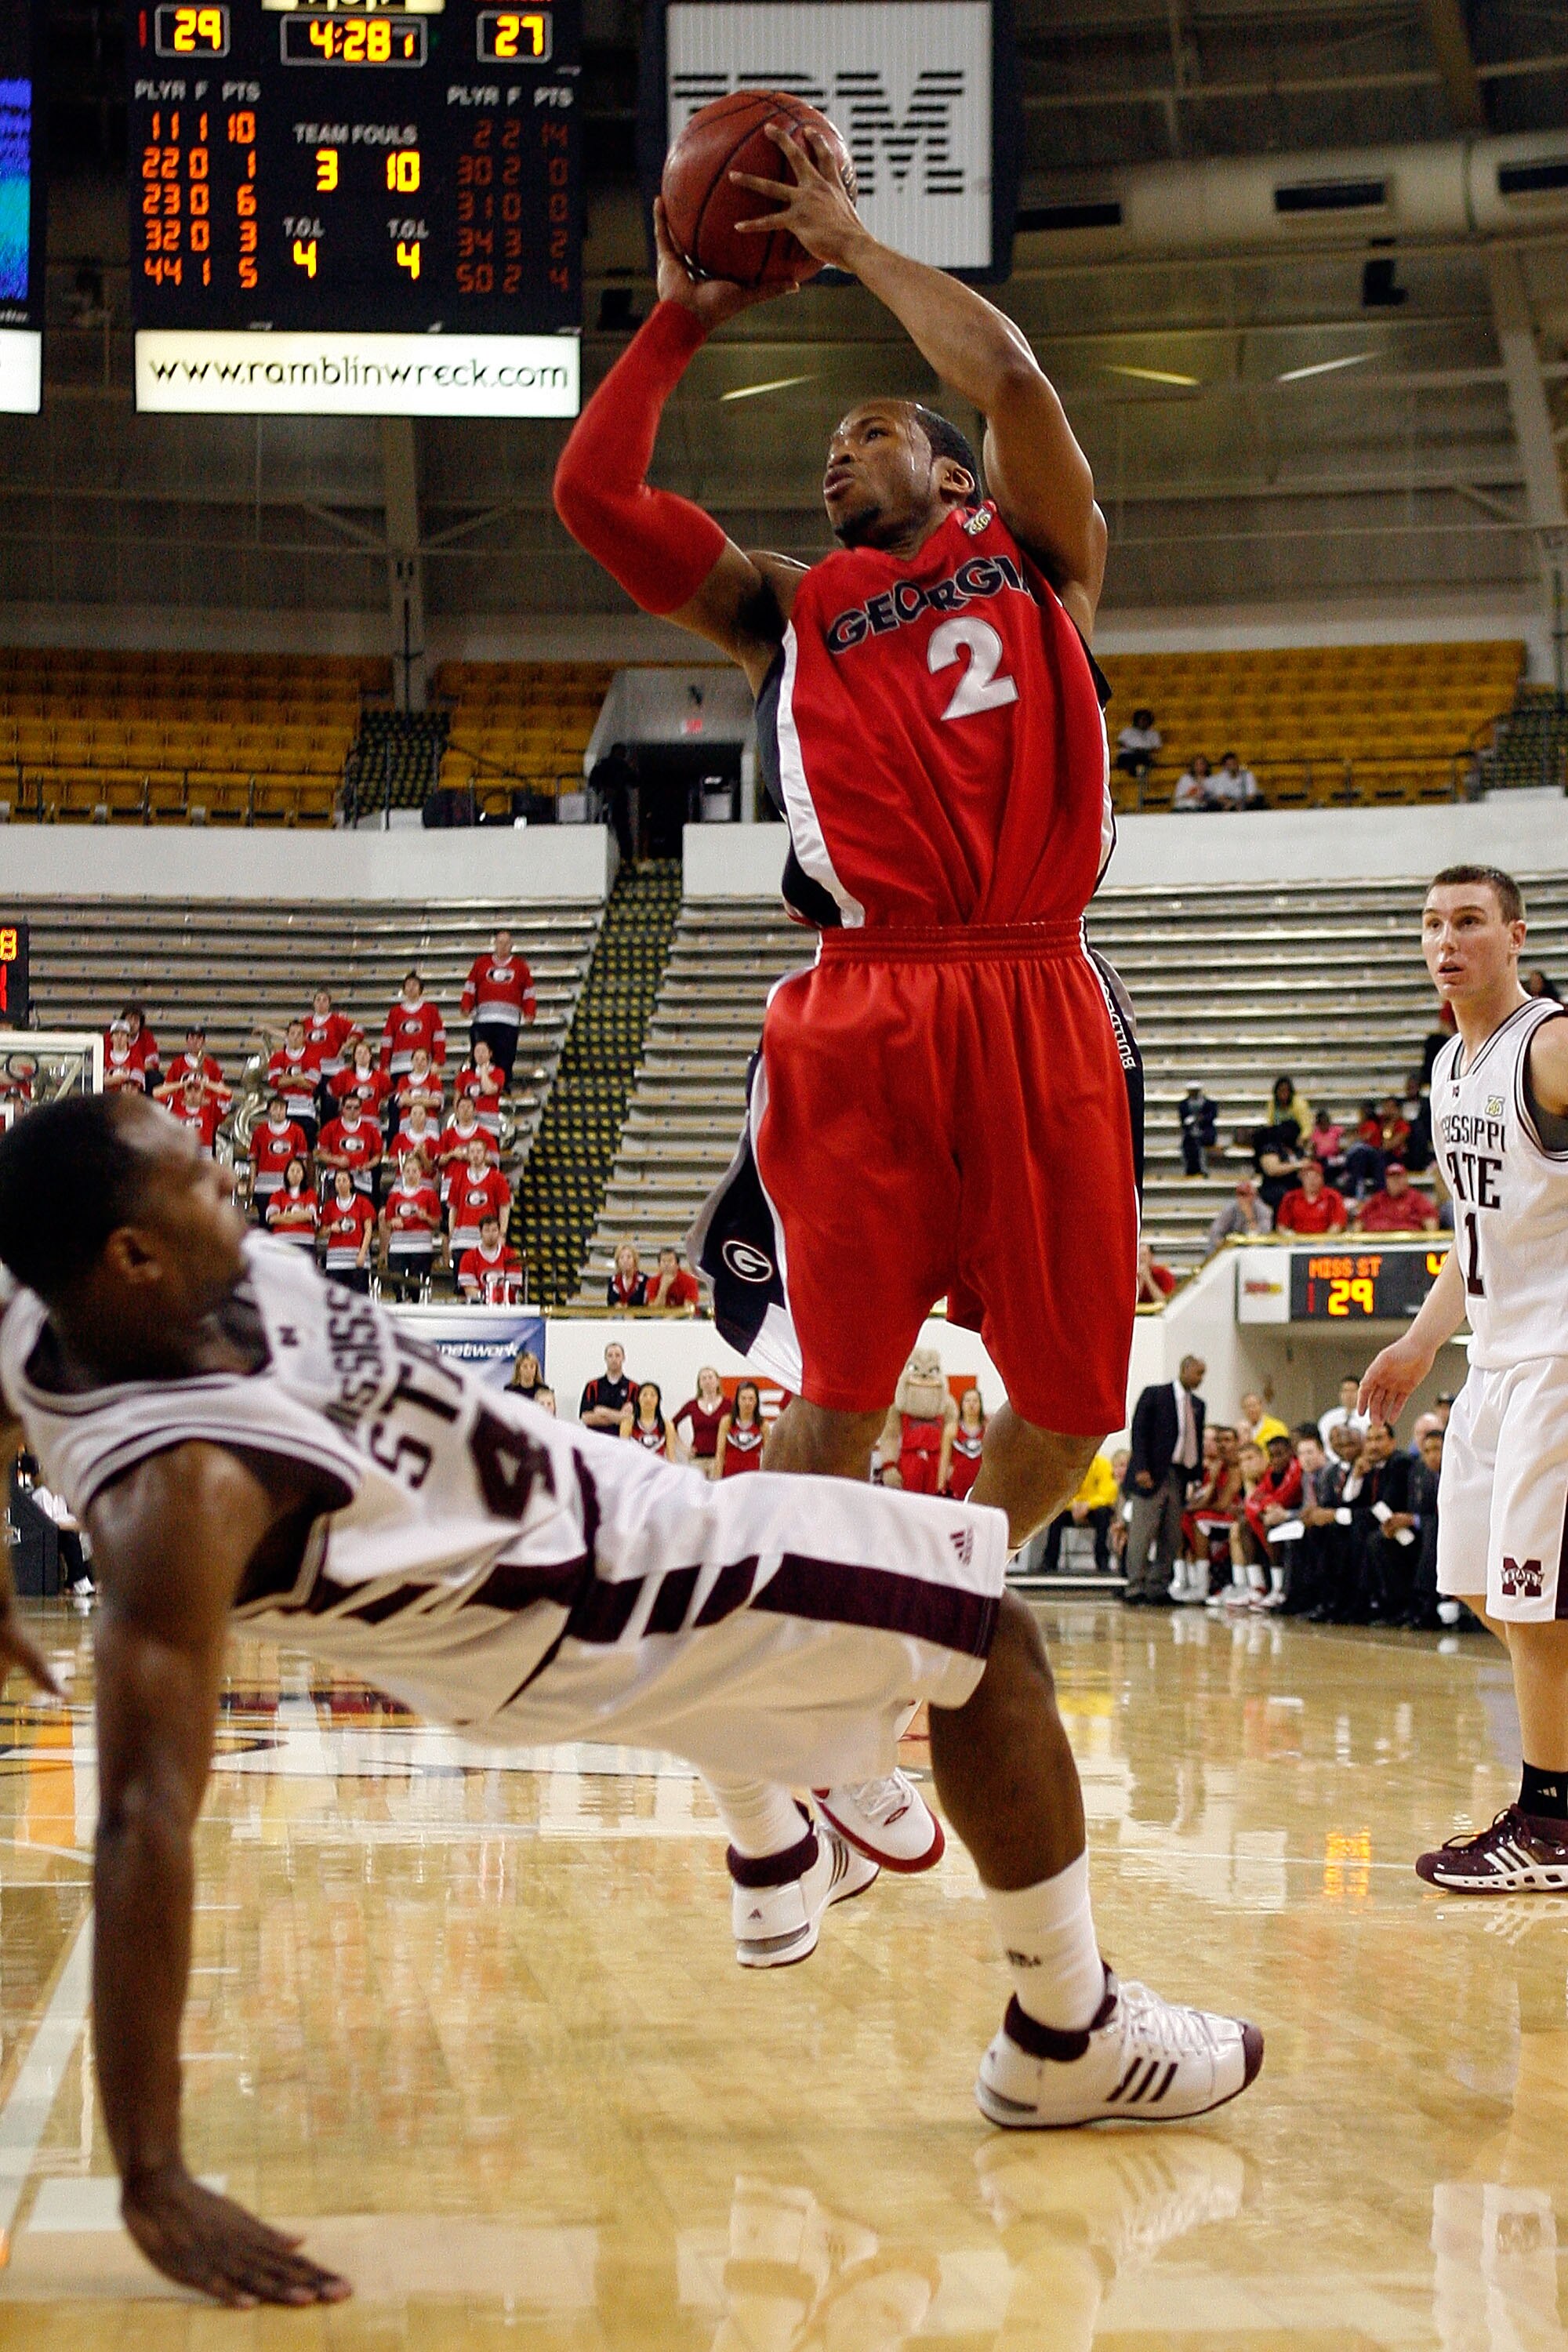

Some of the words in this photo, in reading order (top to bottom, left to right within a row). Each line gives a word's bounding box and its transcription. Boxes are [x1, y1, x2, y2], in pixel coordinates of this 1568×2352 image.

[174, 8, 221, 52] 29
[309, 19, 391, 62] 4:28
[495, 14, 543, 57] 27
[134, 80, 186, 101] PLYR
[195, 81, 209, 101] F
[222, 82, 261, 102] PTS
[447, 85, 499, 107] PLYR
[507, 86, 521, 107] F
[534, 86, 574, 108] PTS
[199, 111, 208, 142] 1
[227, 111, 256, 143] 10
[292, 122, 350, 144] TEAM
[351, 122, 419, 146] FOULS
[142, 147, 180, 179] 22
[189, 147, 209, 179] 0
[248, 148, 256, 179] 1
[315, 149, 339, 191] 3
[387, 150, 421, 192] 10
[143, 183, 181, 215] 23
[190, 183, 209, 215] 0
[237, 183, 257, 216] 6
[145, 219, 181, 251] 32
[191, 220, 210, 251] 0
[239, 220, 258, 252] 3
[144, 256, 182, 286] 44
[202, 257, 211, 286] 1
[238, 256, 258, 288] 5
[292, 239, 317, 278] 4
[396, 241, 421, 281] 4
[150, 354, 569, 389] www.ramblinwreck.com
[927, 616, 1018, 721] 2
[1446, 1152, 1502, 1210] ATE
[1308, 1257, 1353, 1279] MISS
[1356, 1256, 1382, 1278] ST
[1465, 1212, 1484, 1295] 1
[1327, 1278, 1374, 1316] 29
[370, 1332, 465, 1488] STA
